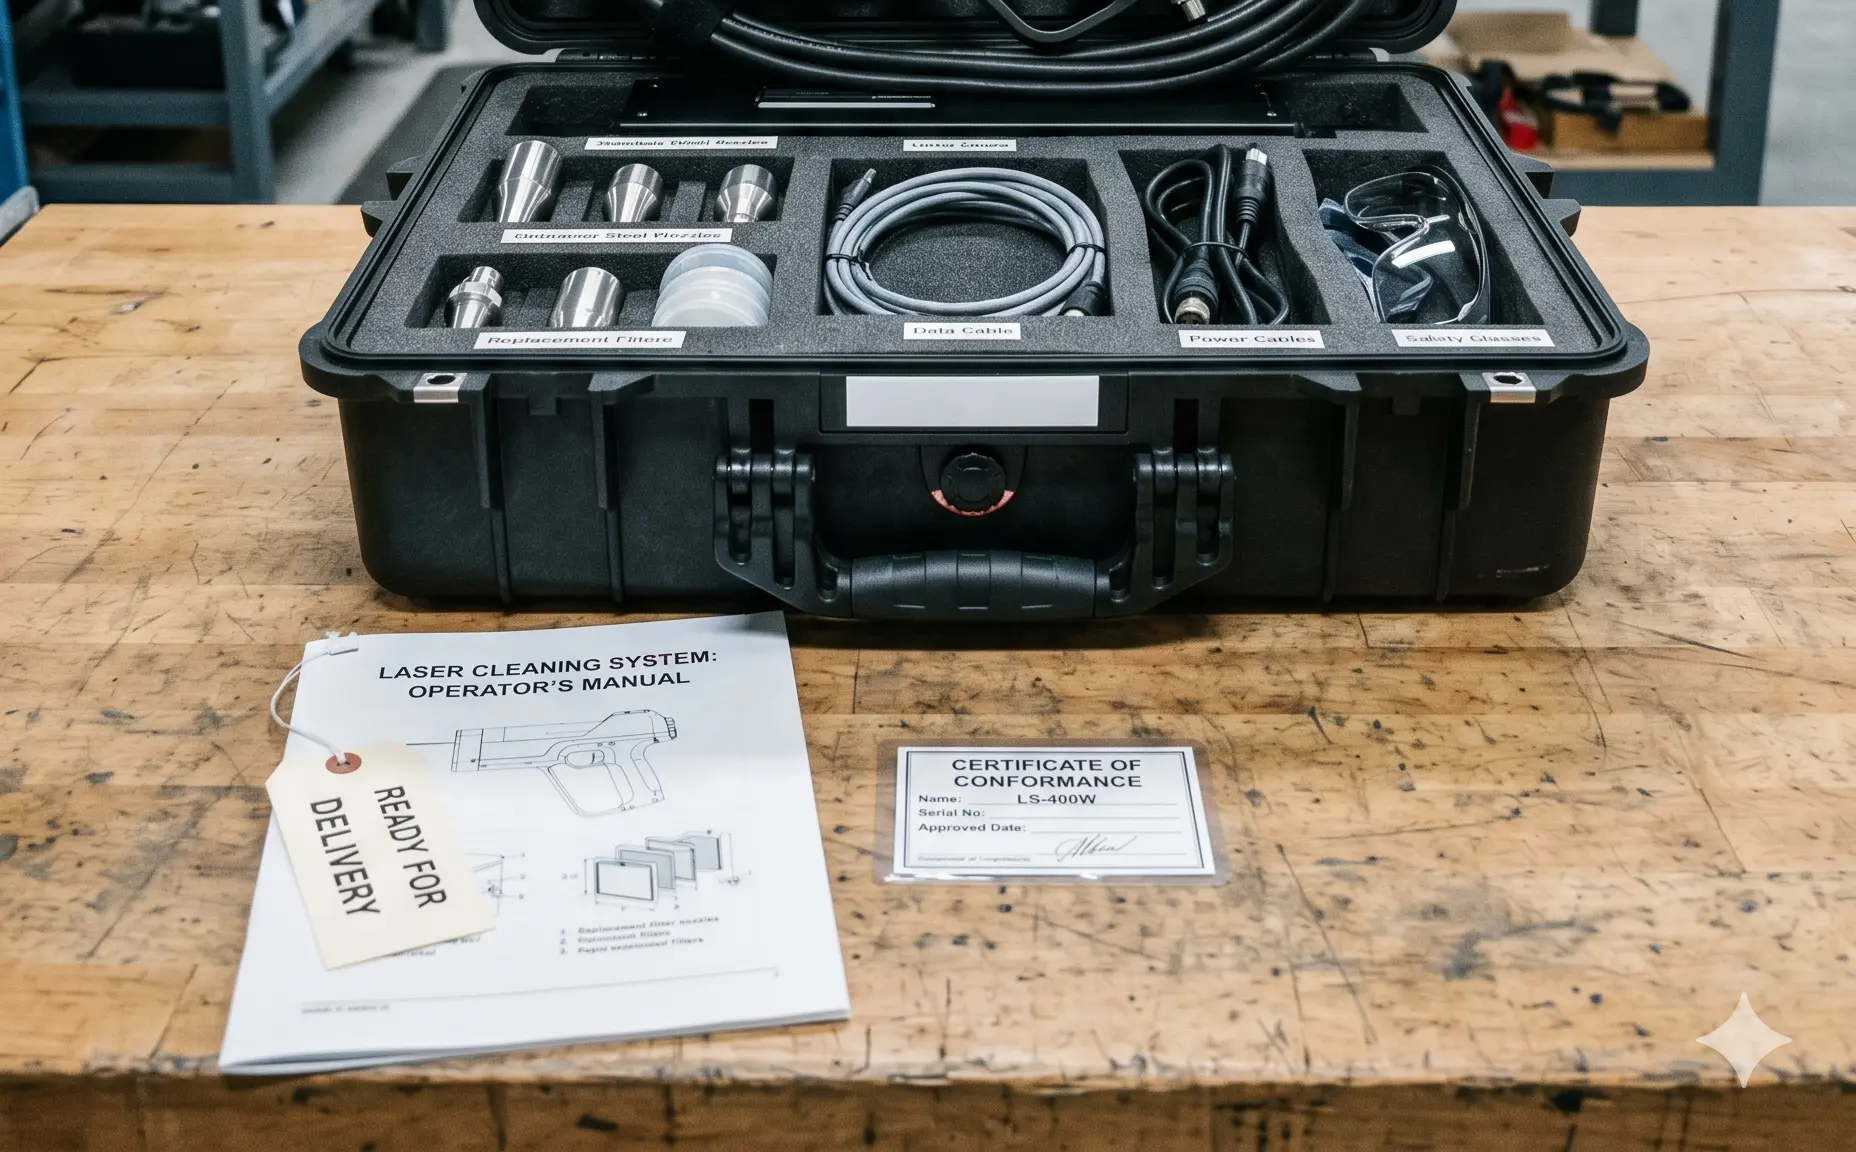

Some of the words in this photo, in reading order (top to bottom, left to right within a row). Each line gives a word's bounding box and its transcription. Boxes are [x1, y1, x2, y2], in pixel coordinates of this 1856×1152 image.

[1189, 335, 1248, 343] Power
[379, 665, 464, 679] LASER
[472, 659, 601, 677] CLEANING
[609, 651, 717, 669] SYSTEM:
[408, 680, 574, 698] OPERATOR'S
[582, 672, 690, 690] MANUAL
[951, 759, 1104, 772] CERTIFICATE
[1110, 759, 1142, 772] OF
[953, 775, 1143, 788] CONFORMANCE
[918, 795, 962, 803] Name:
[1017, 794, 1097, 804] LS-400W
[918, 809, 957, 817] Serial
[962, 809, 985, 817] No:
[918, 823, 986, 833] Approved
[991, 824, 1027, 832] Date:
[374, 786, 429, 852] READY
[403, 860, 447, 908] FOR
[310, 797, 381, 915] DELIVERY
